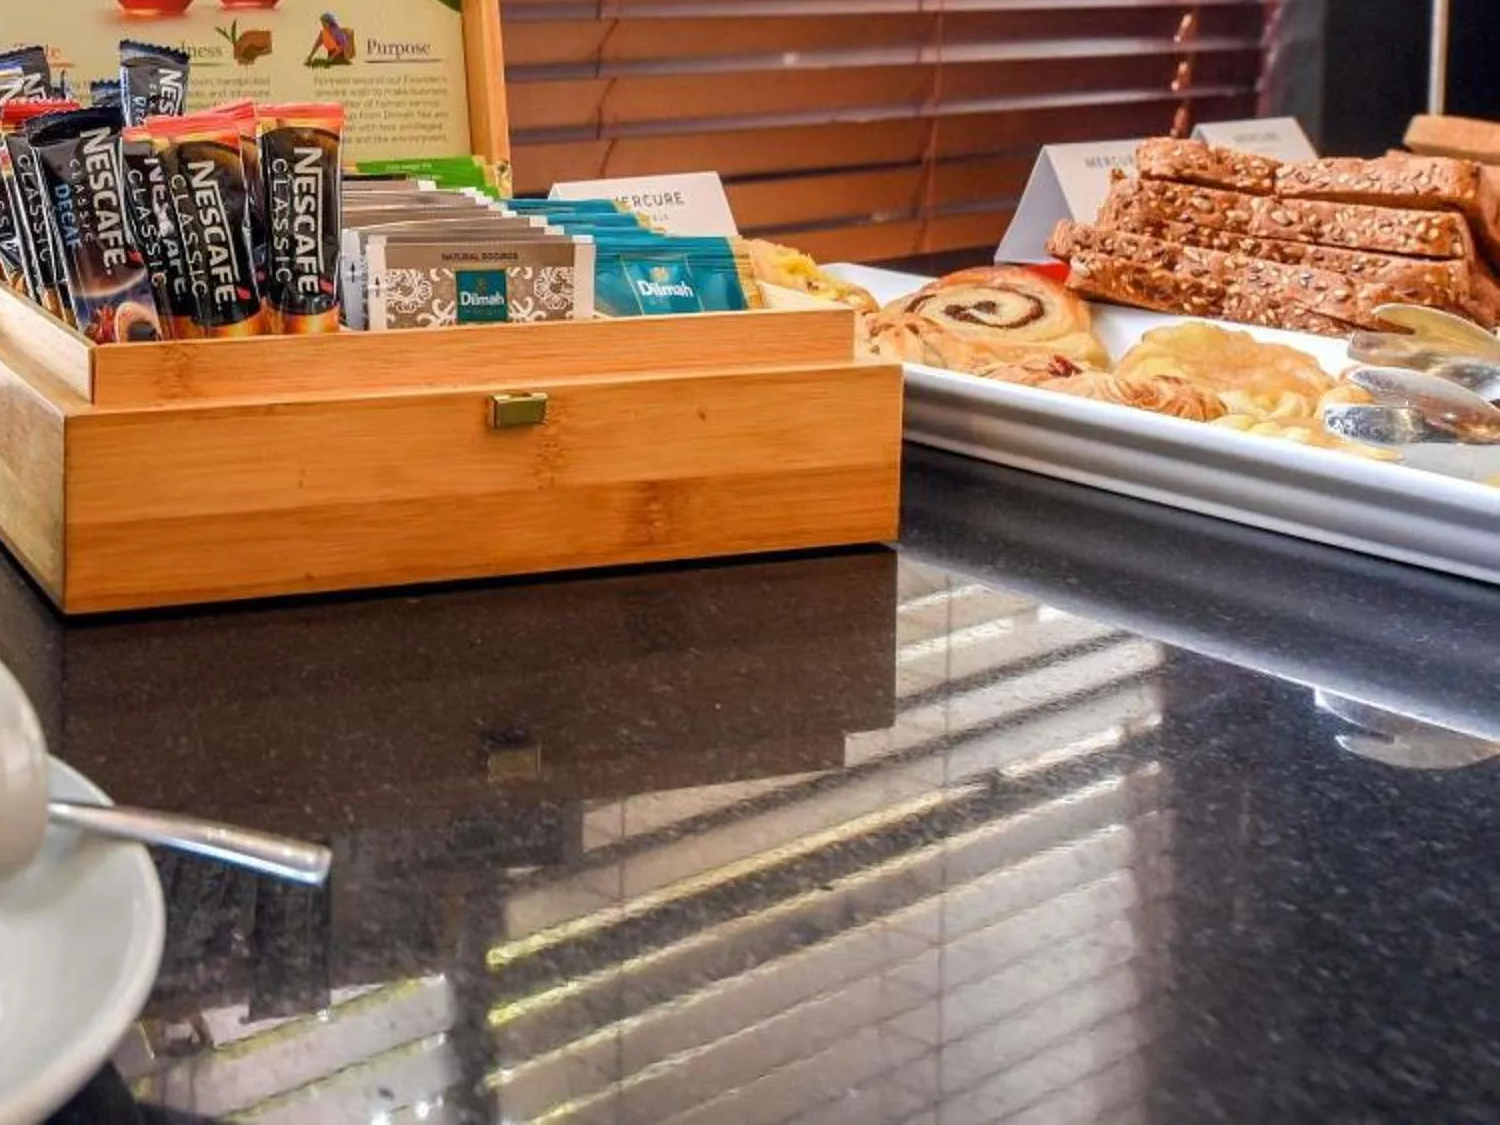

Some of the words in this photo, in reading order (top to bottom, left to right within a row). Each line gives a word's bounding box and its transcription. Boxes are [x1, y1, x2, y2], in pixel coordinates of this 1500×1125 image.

[366, 38, 433, 59] Purpose
[69, 158, 94, 243] CLASSIC
[615, 190, 686, 208] ERCURE
[271, 158, 293, 283] CLASSIC
[170, 174, 209, 296] CLASSIC
[460, 289, 506, 306] Dilmah
[635, 279, 695, 299] Dilmah
